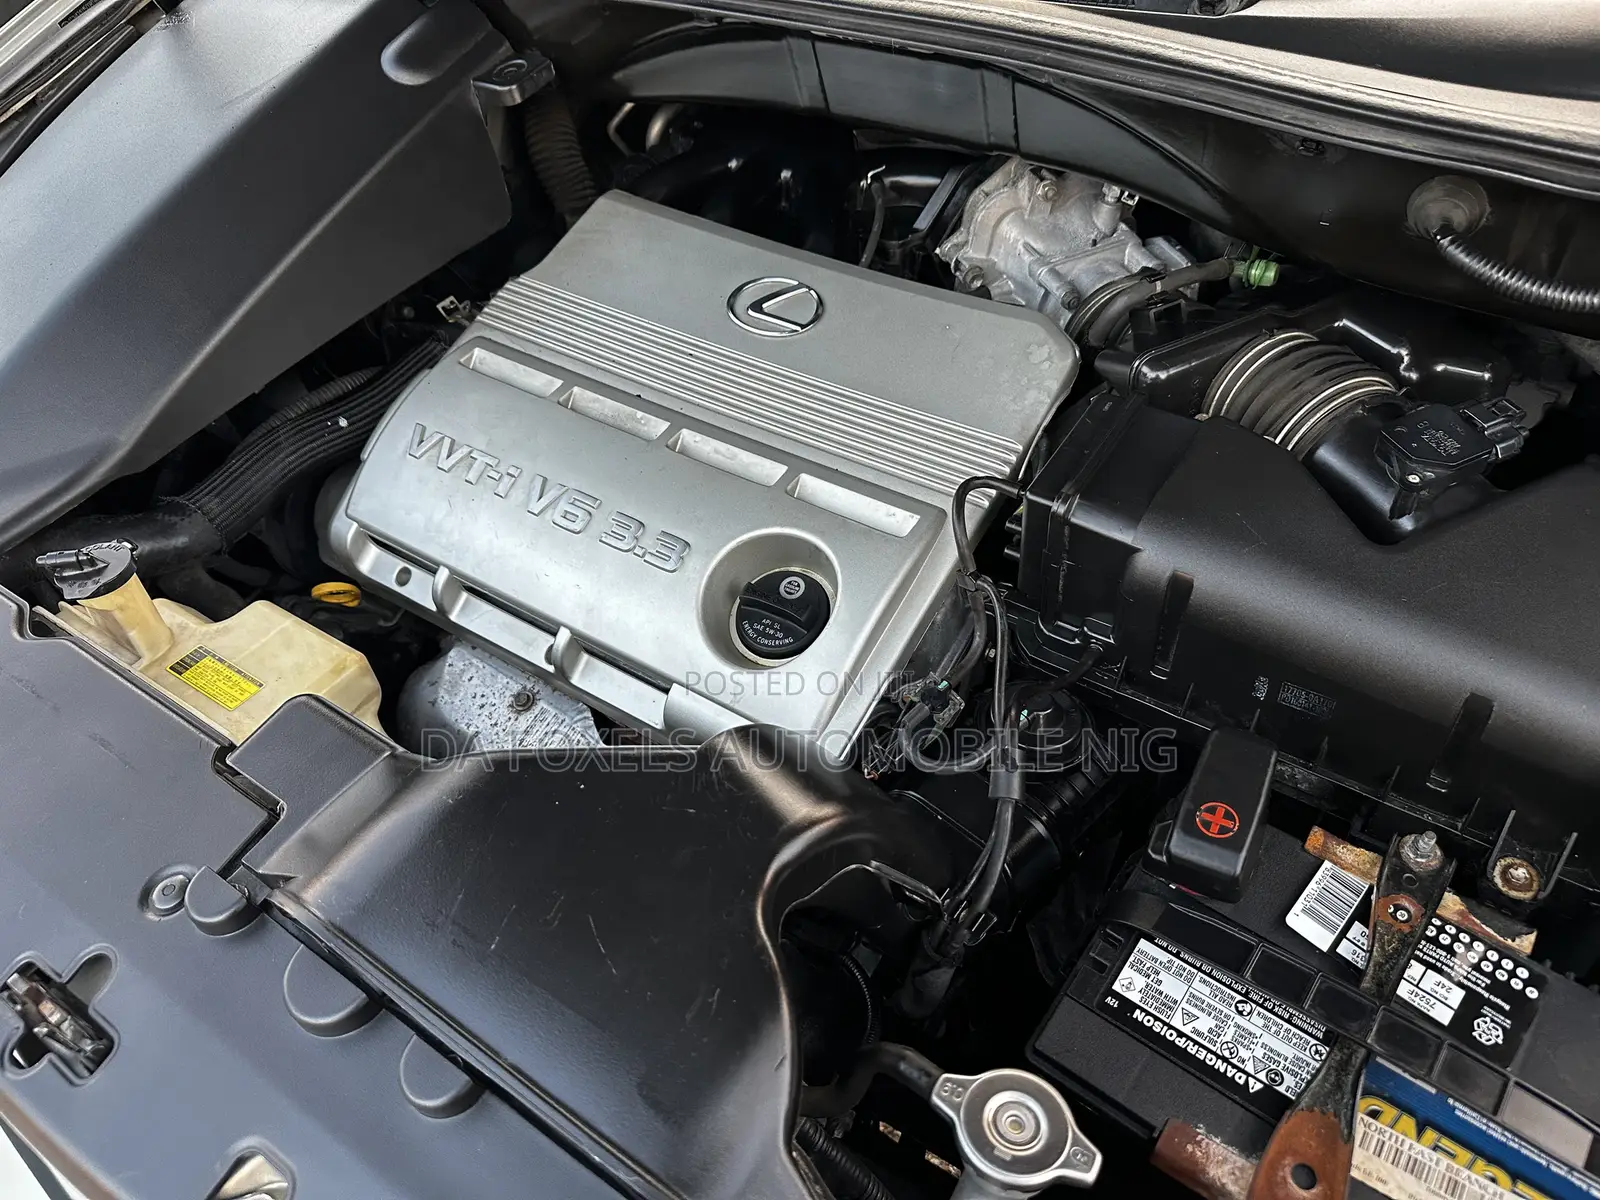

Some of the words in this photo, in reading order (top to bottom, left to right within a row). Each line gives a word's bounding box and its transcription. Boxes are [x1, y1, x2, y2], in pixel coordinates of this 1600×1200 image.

[408, 422, 523, 499] VVT-i
[527, 473, 602, 535] V6
[599, 511, 691, 573] 3.3
[753, 622, 763, 632] SAE
[765, 627, 784, 638] 5W-30
[762, 618, 771, 626] API
[774, 622, 781, 630] SL
[742, 620, 757, 639] ENERGY
[757, 636, 794, 646] CONSERVING
[1422, 945, 1440, 960] PARTS
[1130, 954, 1147, 968] FAST.
[1157, 959, 1172, 972] OPEN
[1164, 956, 1176, 966] TIP.
[1175, 962, 1187, 972] NOT
[1438, 955, 1454, 968] AUTO
[1126, 961, 1151, 980] MEDICAL
[1145, 963, 1161, 976] HELP
[1172, 968, 1183, 978] NOT
[1185, 968, 1195, 977] DO
[1150, 975, 1162, 986] GET
[1182, 974, 1192, 983] DO
[1210, 967, 1246, 994] EXPLOSION
[1433, 977, 1453, 994] 24F
[1141, 979, 1164, 997] WATER.
[1195, 973, 1237, 1003] INSTRUCTIONS.
[1207, 989, 1219, 999] ALL
[1104, 994, 1120, 1008] 12V
[1137, 986, 1175, 1013] IMMEDIATELY
[1138, 995, 1153, 1008] EYES
[1162, 992, 1179, 1006] WITH
[1217, 995, 1233, 1008] READ
[1262, 999, 1273, 1009] OF
[1406, 985, 1437, 1009] 7524F
[1152, 1004, 1171, 1019] FLUSH
[1184, 997, 1212, 1017] BLINDNESS
[1204, 1001, 1223, 1016] SEVERE
[1272, 1004, 1290, 1019] RISK
[1211, 1013, 1228, 1026] CAUSE
[1223, 1012, 1231, 1020] OR
[1206, 1026, 1222, 1039] ACID
[1213, 1022, 1225, 1032] CAN
[1261, 1021, 1273, 1031] THE
[1271, 1027, 1281, 1036] OF
[1282, 1026, 1291, 1035] OF
[1288, 1013, 1324, 1040] WARNING:
[1189, 1025, 1218, 1047] SULFURIC
[1280, 1032, 1293, 1043] OUT
[1290, 1031, 1310, 1046] REACH
[1131, 1007, 1247, 1085] DANGER/POISON
[1259, 1041, 1288, 1062] BLINDNESS
[1292, 1039, 1307, 1052] KEEP
[1235, 1055, 1246, 1065] NO
[1260, 1051, 1281, 1067] GASES
[1287, 1058, 1305, 1072] CAUSE
[1290, 1052, 1311, 1068] INJURY.
